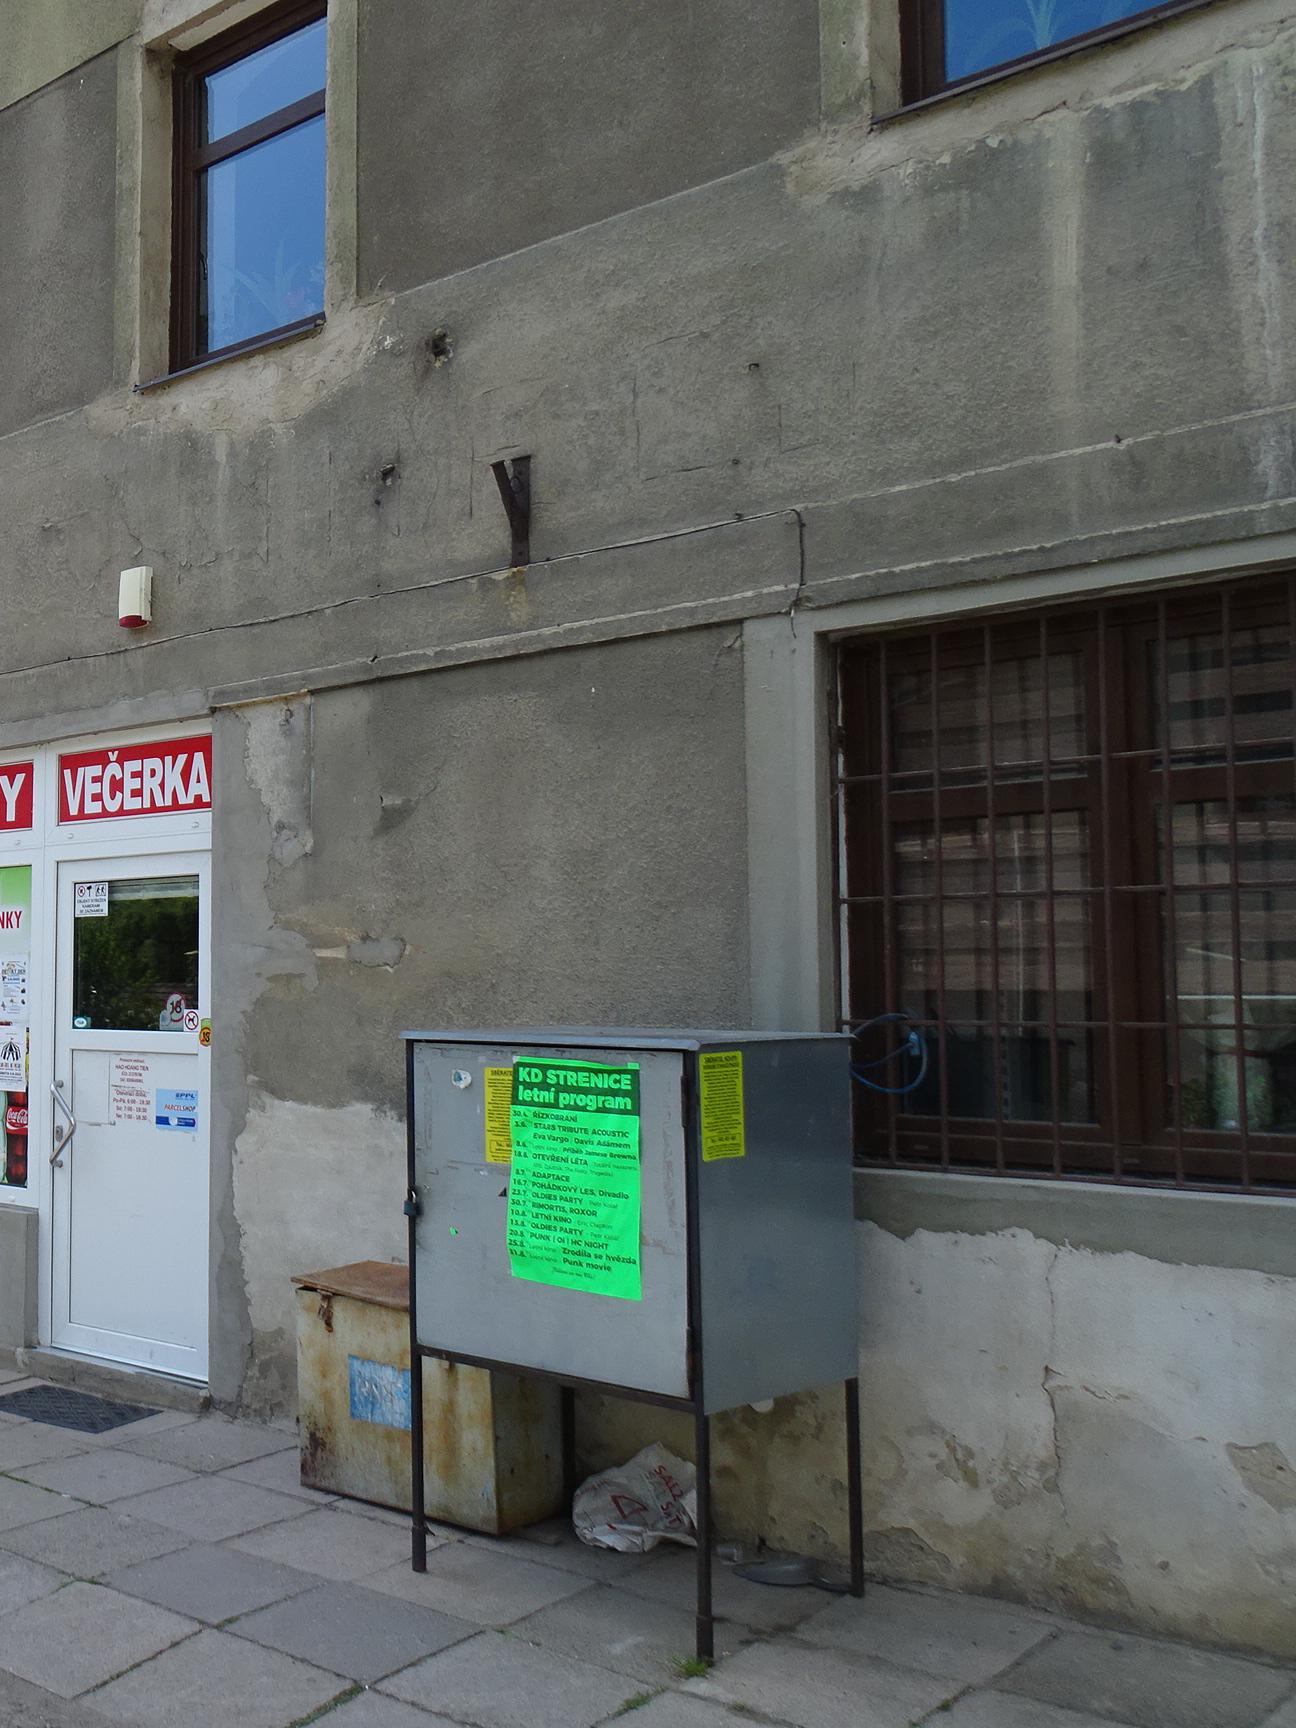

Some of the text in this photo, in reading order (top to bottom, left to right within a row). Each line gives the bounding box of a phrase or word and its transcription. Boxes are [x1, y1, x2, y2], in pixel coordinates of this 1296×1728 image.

[64, 751, 210, 816] VEČERKA
[518, 1067, 632, 1090] KD STRENICE
[518, 1085, 632, 1111] letní program
[533, 1132, 547, 1140] Eva
[547, 1134, 569, 1143] Vargo
[558, 1125, 589, 1135] TRIBUTE
[591, 1128, 629, 1138] ACOUSTIC
[531, 1171, 570, 1182] ADAPTACE
[531, 1191, 557, 1201] OLDIES
[559, 1194, 583, 1205] PARTY
[598, 1189, 629, 1200] Divadlo
[569, 1207, 598, 1217] ROXOR
[552, 1215, 572, 1224] KINO
[530, 1222, 557, 1232] OLDIES
[559, 1226, 583, 1236] PARTY
[529, 1232, 551, 1241] PUNK
[584, 1241, 609, 1250] NIGHT
[561, 1247, 592, 1258] Zrodila
[605, 1253, 637, 1265] hvězda
[562, 1257, 584, 1268] Punk
[585, 1261, 612, 1272] movie
